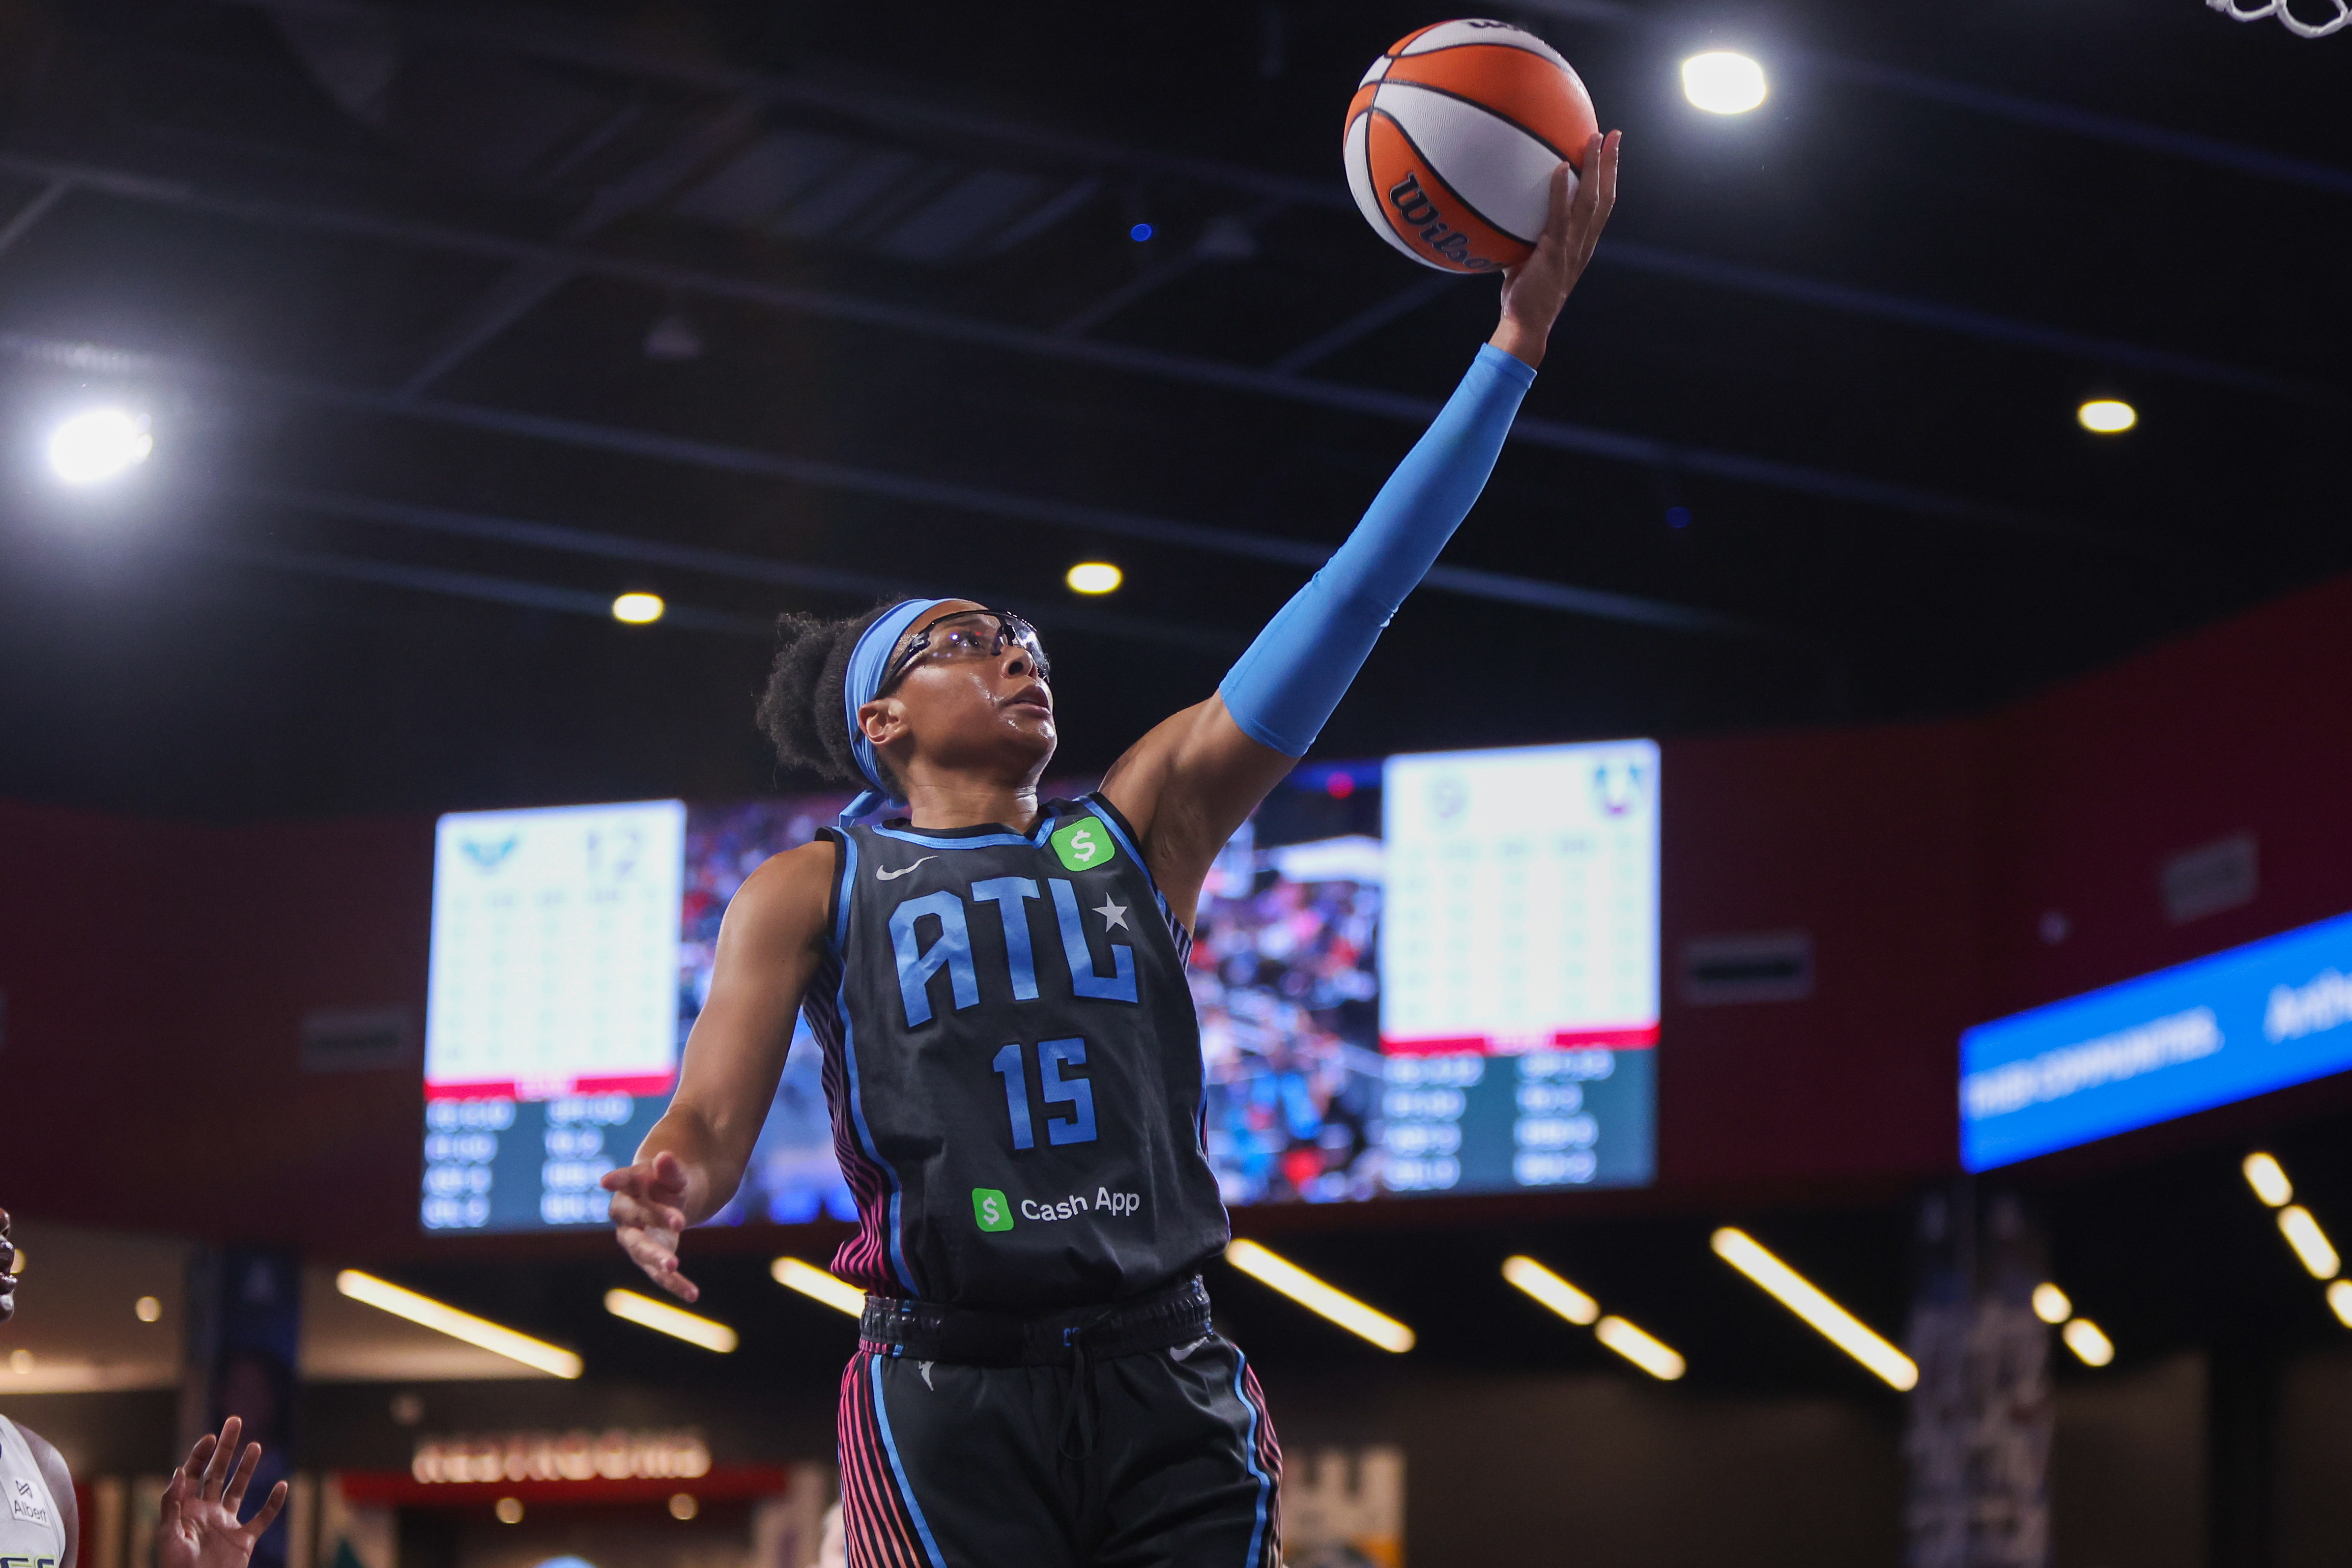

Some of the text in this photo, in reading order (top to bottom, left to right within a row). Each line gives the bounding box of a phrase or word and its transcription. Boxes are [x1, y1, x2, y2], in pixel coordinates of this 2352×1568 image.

[888, 876, 1139, 1028] ATL
[992, 1037, 1097, 1150] 15
[1021, 1195, 1089, 1222] Cash
[1094, 1187, 1140, 1217] App
[14, 1499, 47, 1523] Albert
